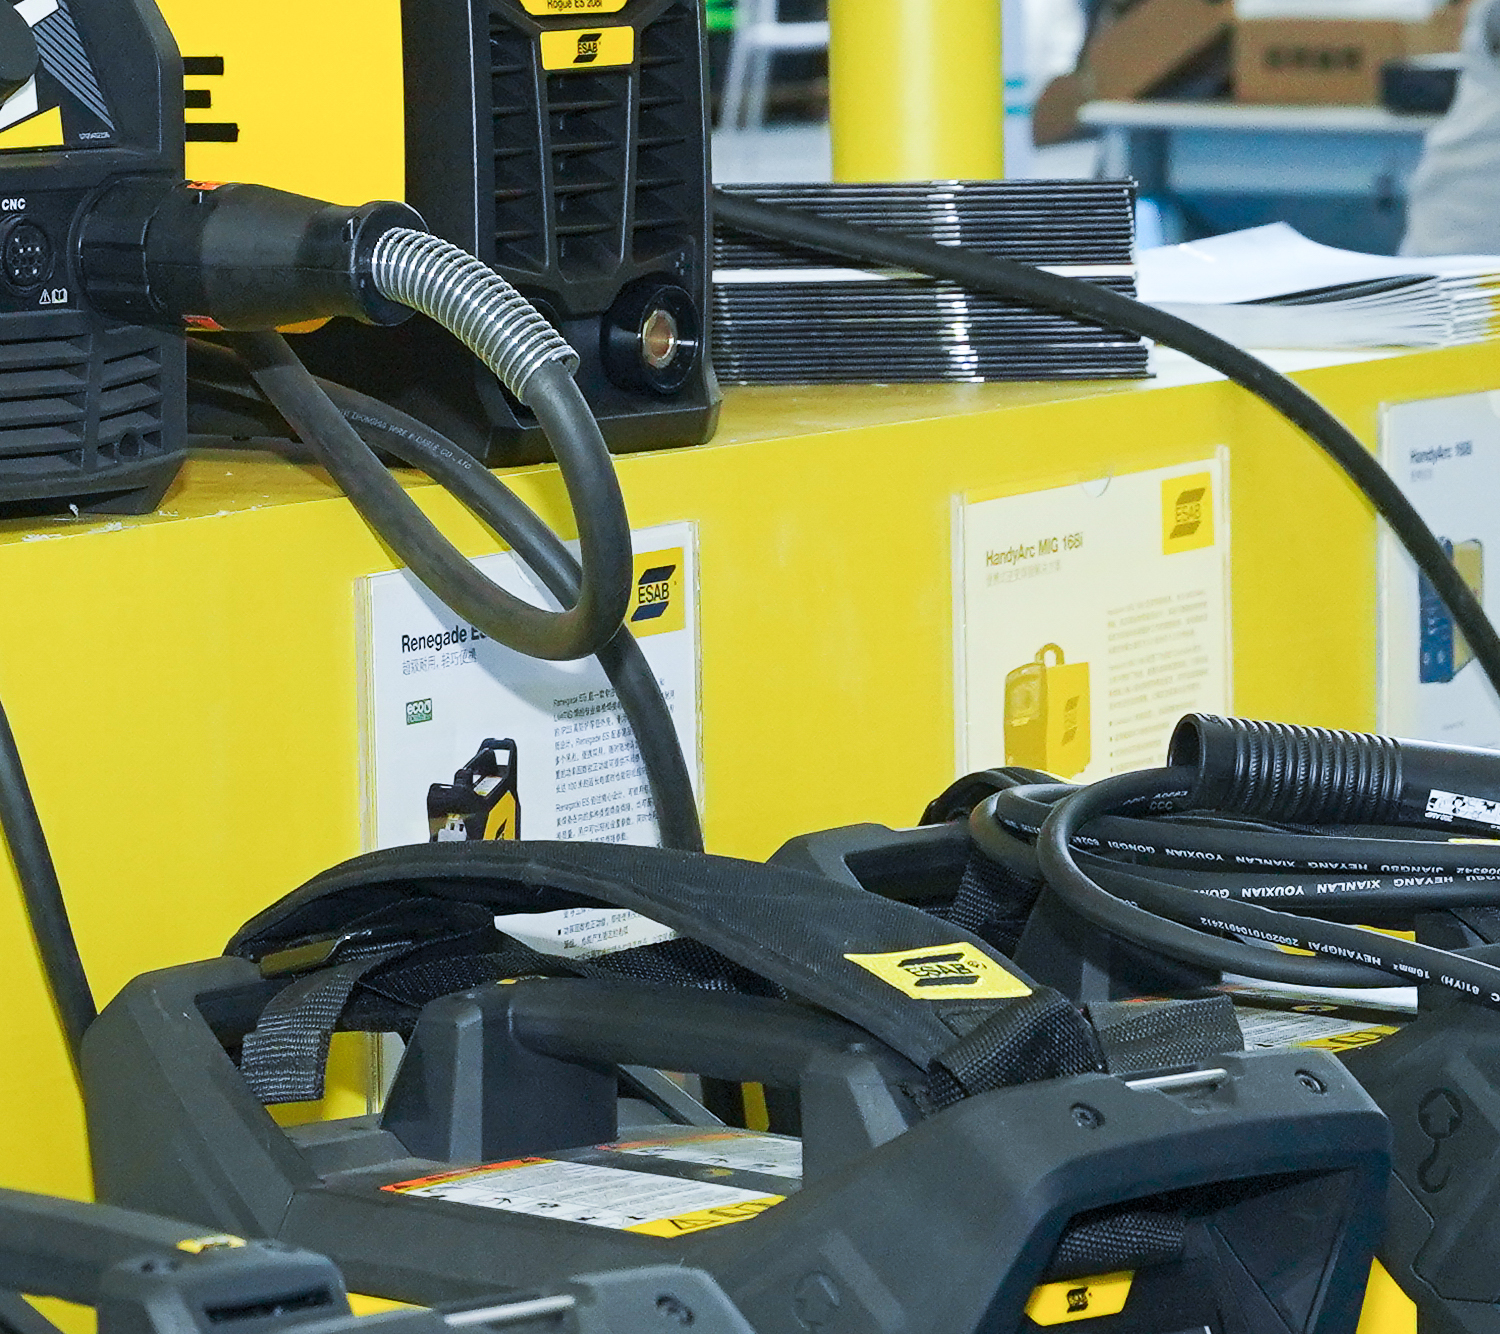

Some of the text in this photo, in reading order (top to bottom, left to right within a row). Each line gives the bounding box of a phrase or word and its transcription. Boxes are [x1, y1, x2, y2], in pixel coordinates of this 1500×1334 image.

[576, 41, 599, 55] ESAB
[1, 197, 27, 212] CNC
[985, 545, 1036, 568] HandyArc
[1038, 536, 1059, 555] MIG
[637, 582, 670, 604] ESAB
[402, 626, 468, 654] Renegade
[1107, 839, 1156, 854] GONGSI
[1164, 847, 1225, 862] YOUXIAN
[1241, 875, 1454, 898] HEYANG XIANLAN YOUXIAN
